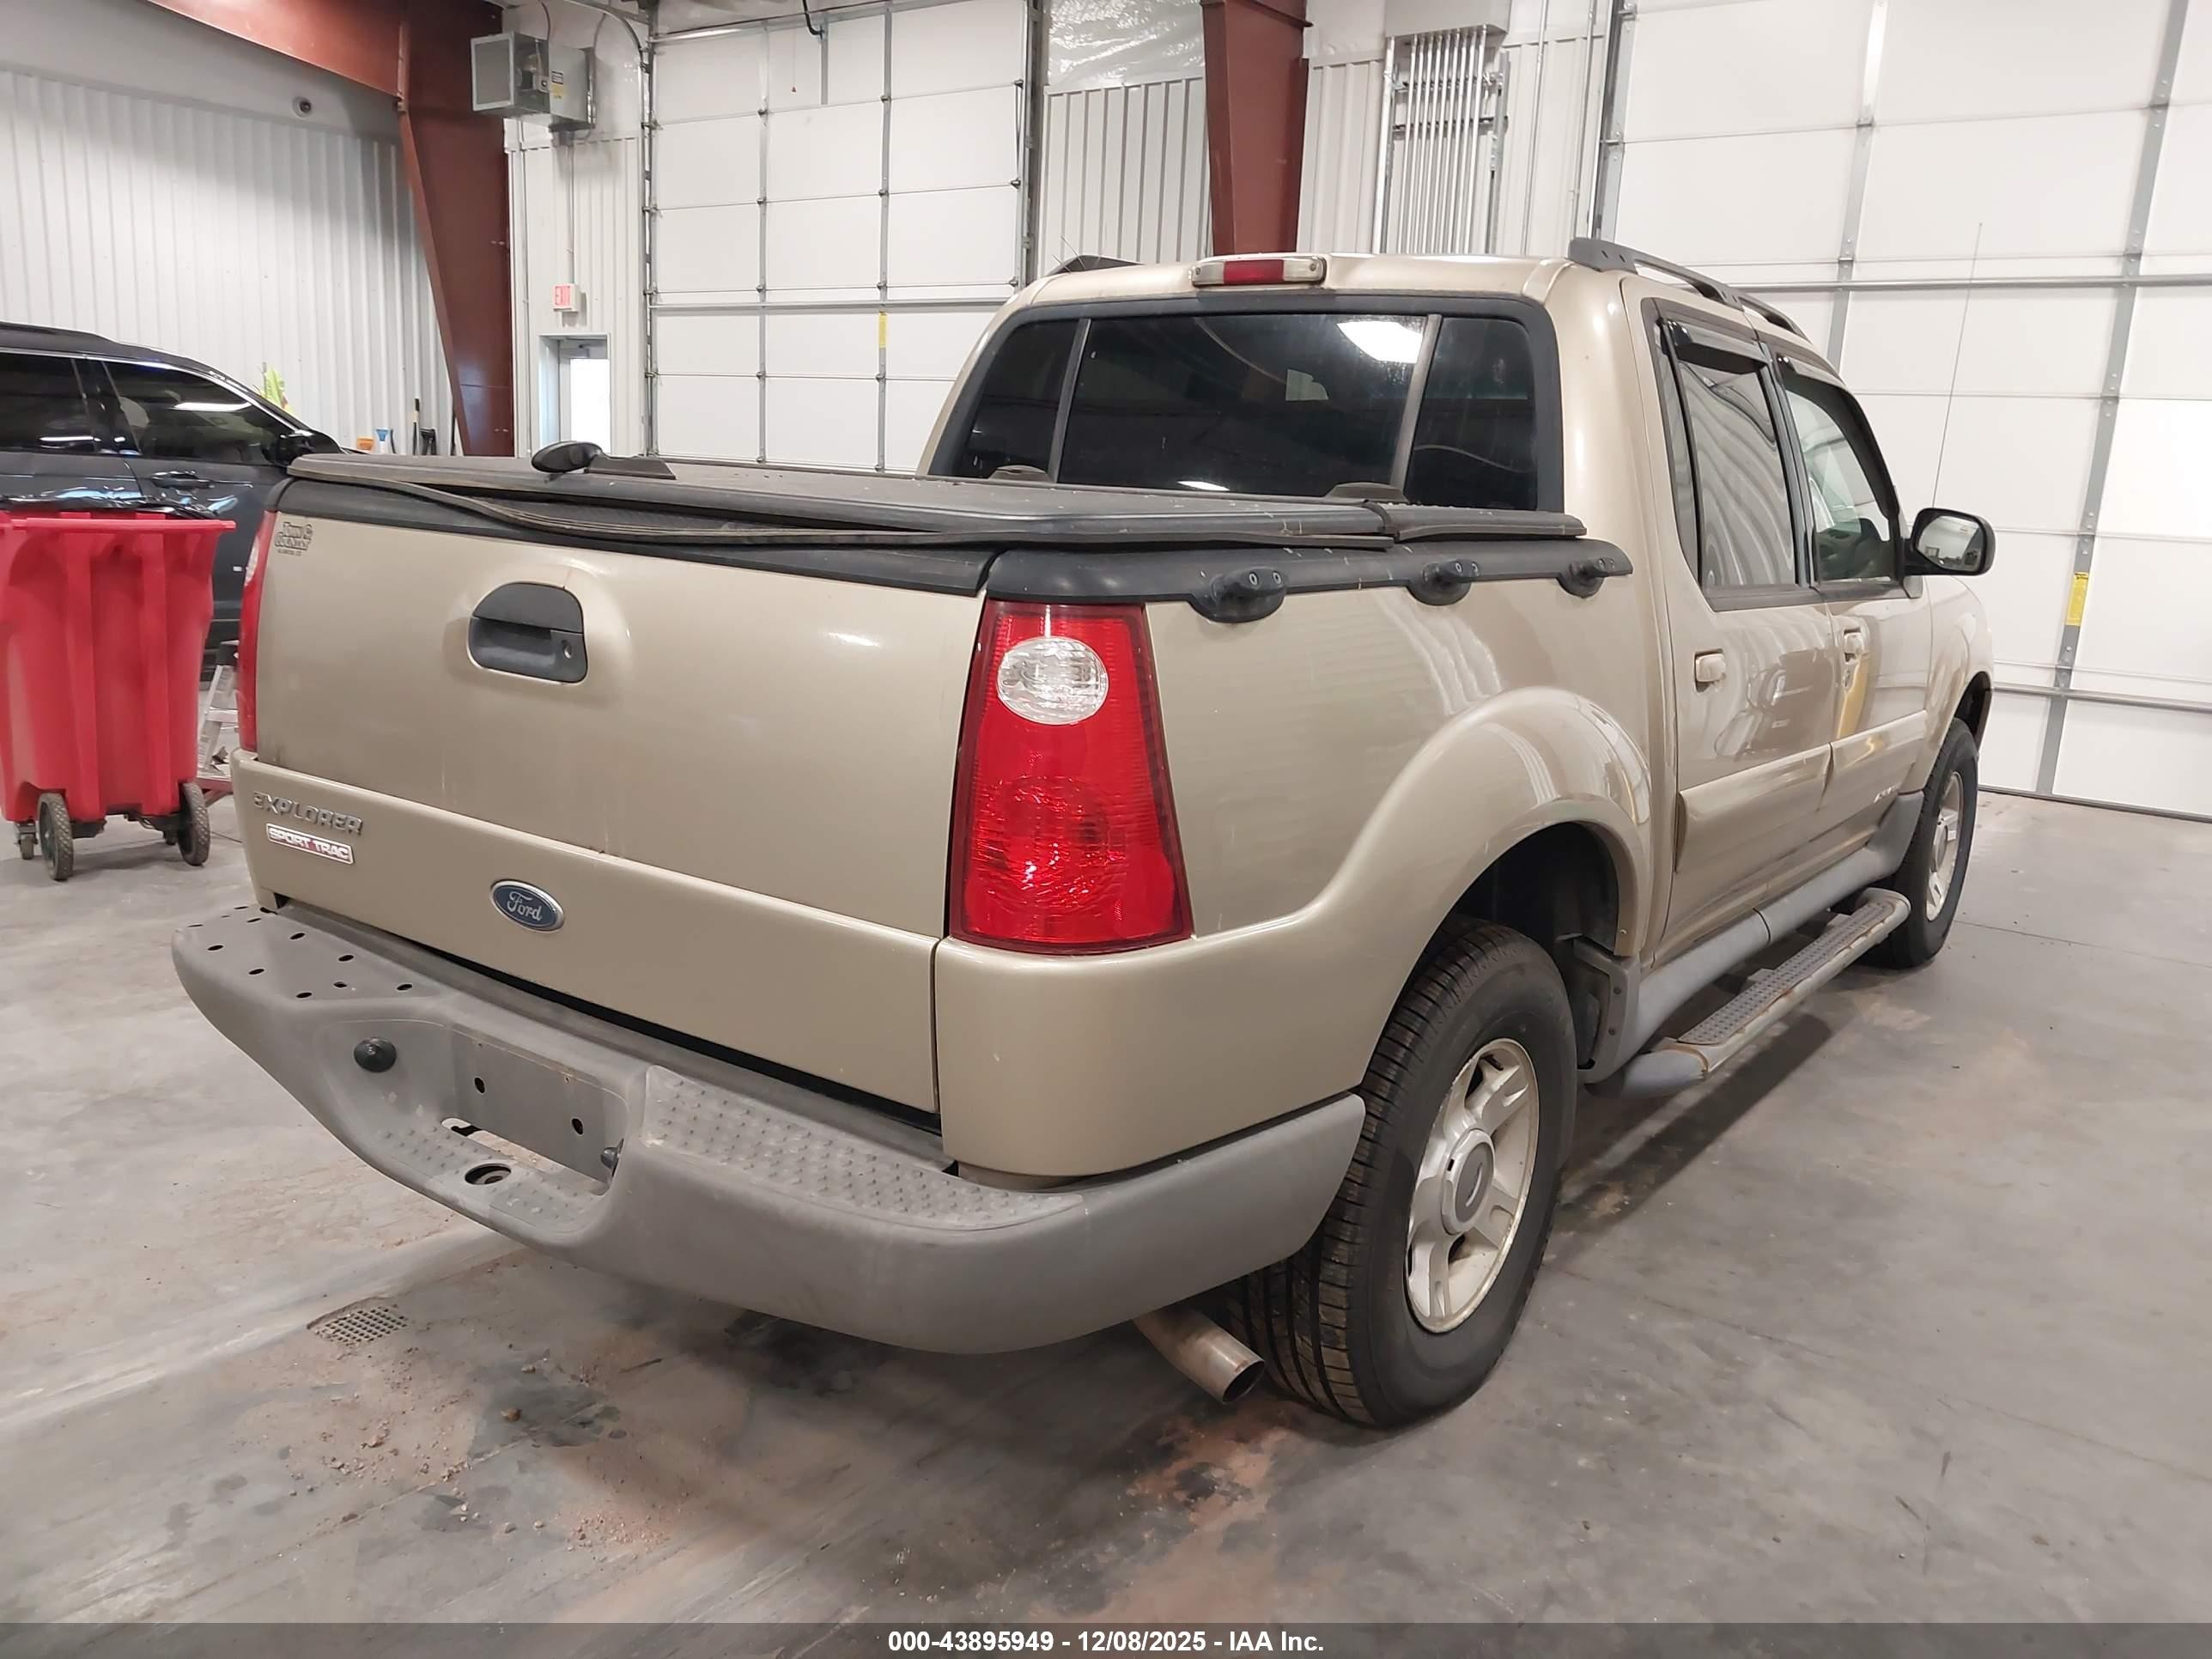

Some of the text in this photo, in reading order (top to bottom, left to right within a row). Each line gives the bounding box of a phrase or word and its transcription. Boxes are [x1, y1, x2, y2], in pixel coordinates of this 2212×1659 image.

[253, 791, 363, 836] EXPLORER
[269, 827, 349, 860] SPORT TRAC
[507, 890, 543, 921] Ford
